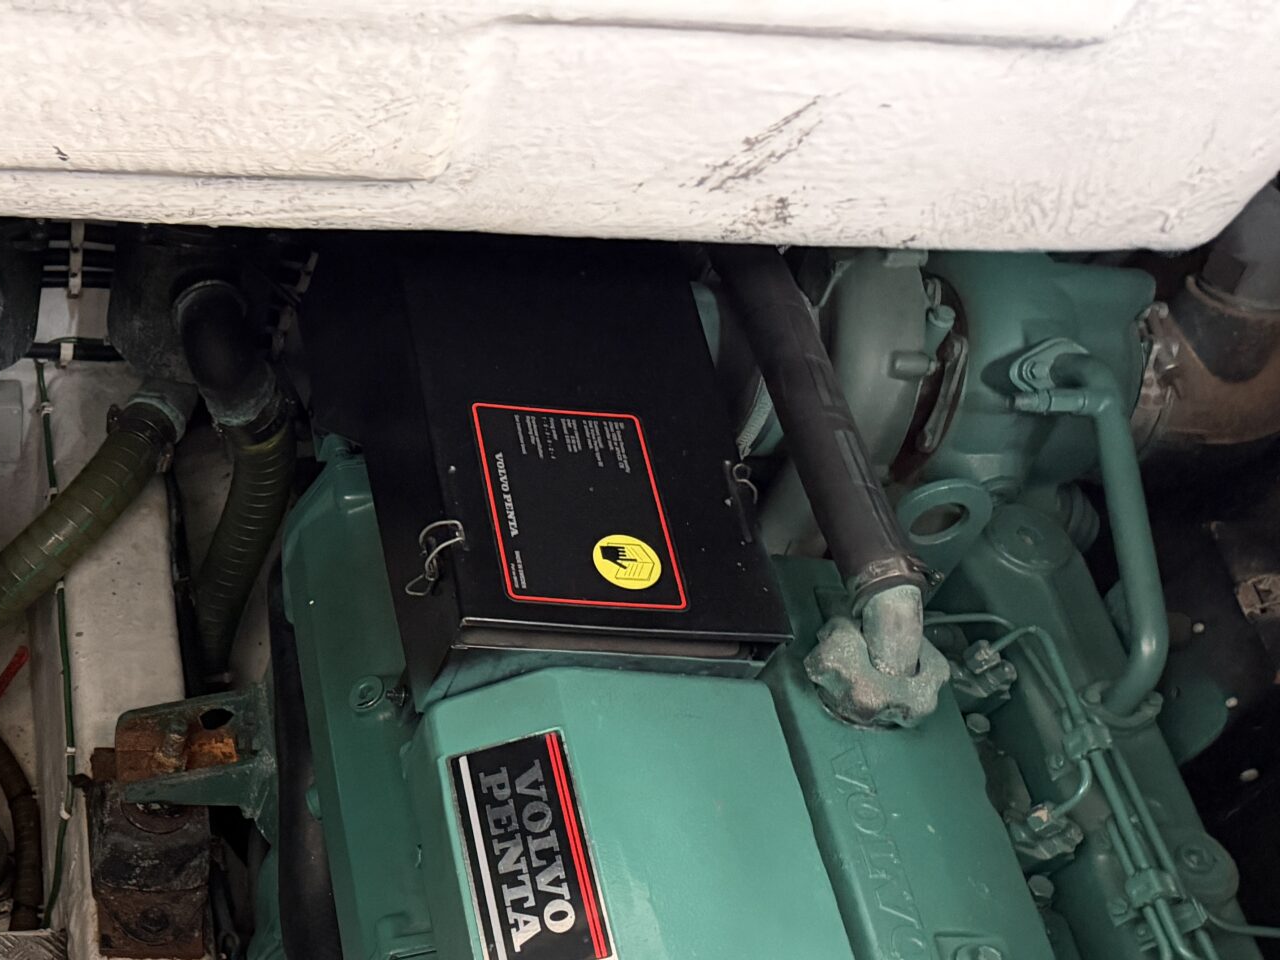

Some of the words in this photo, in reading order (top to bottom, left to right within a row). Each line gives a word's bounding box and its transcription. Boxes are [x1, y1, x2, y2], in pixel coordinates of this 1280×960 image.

[495, 452, 509, 492] VOLVO
[503, 493, 518, 537] PENTA
[479, 766, 540, 952] PENTA
[510, 759, 577, 934] VOLVO
